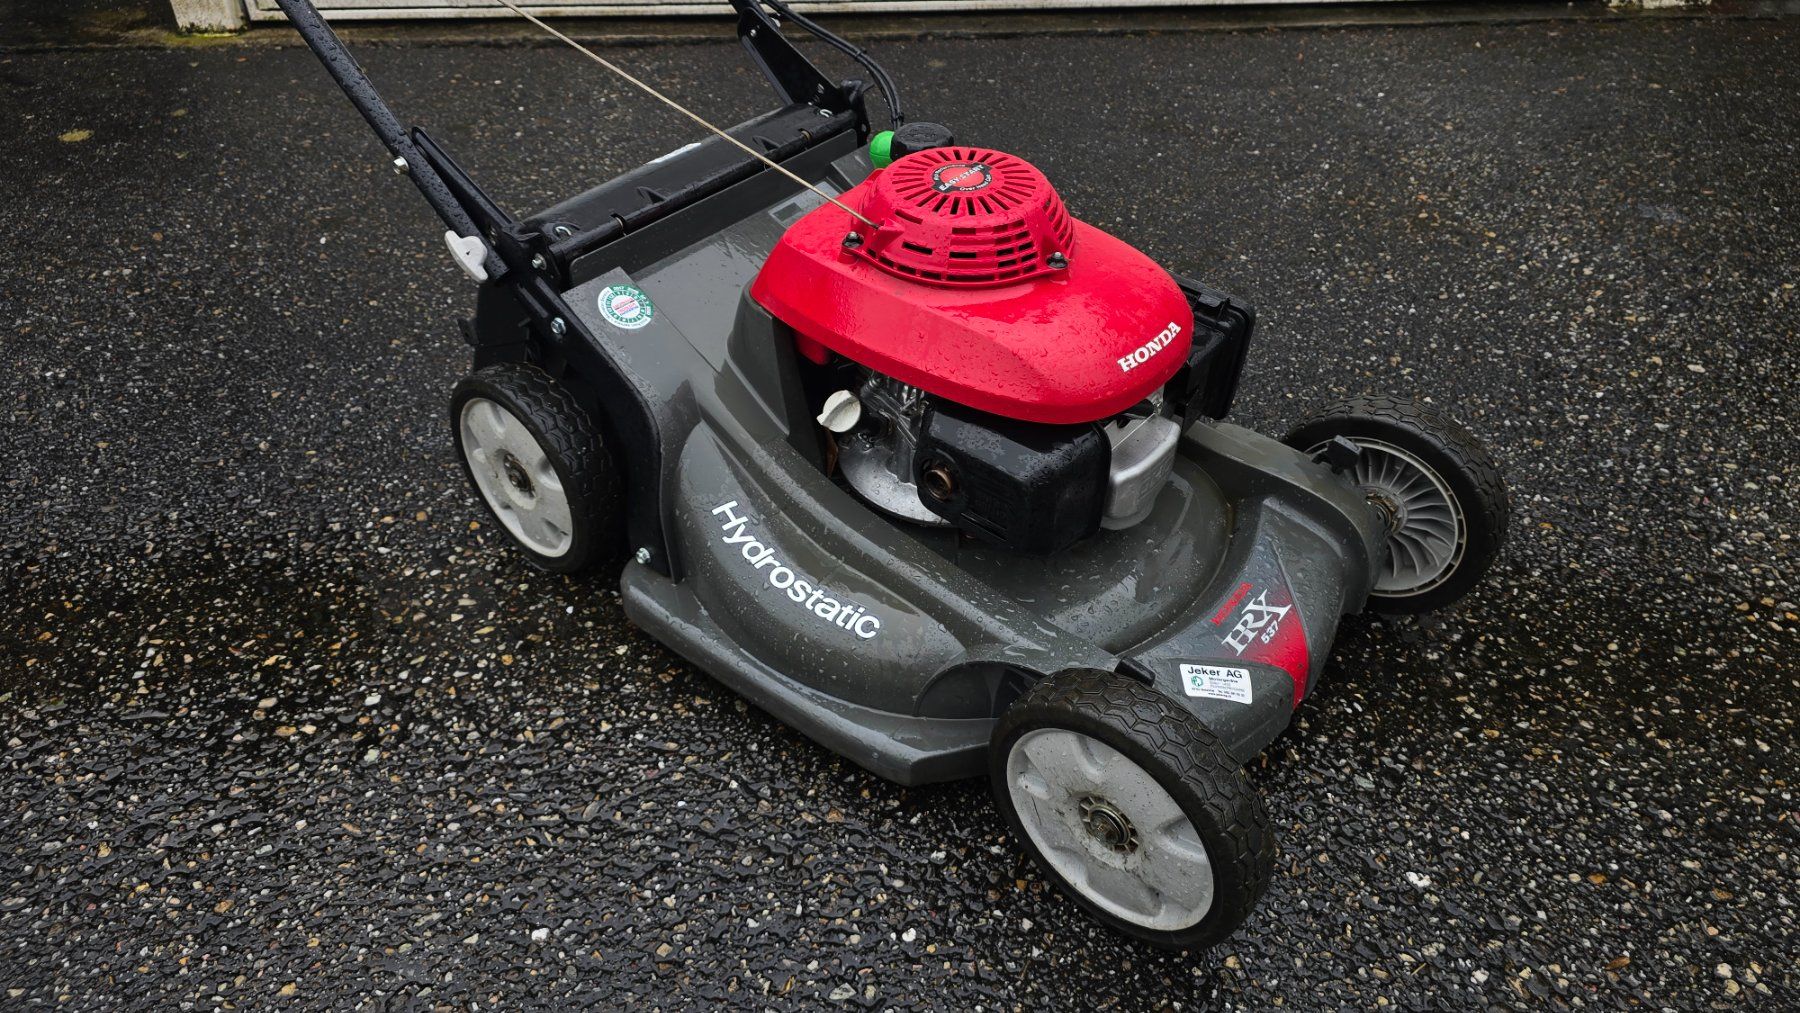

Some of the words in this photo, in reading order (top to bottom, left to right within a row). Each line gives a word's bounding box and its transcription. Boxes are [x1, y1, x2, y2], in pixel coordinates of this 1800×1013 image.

[1117, 321, 1182, 372] HONDA
[711, 500, 880, 639] Hydrostatic
[1209, 582, 1254, 626] HONDA
[1221, 588, 1292, 657] HRX
[1261, 620, 1279, 644] 537
[1187, 666, 1220, 676] Jeker
[1226, 669, 1242, 679] AG
